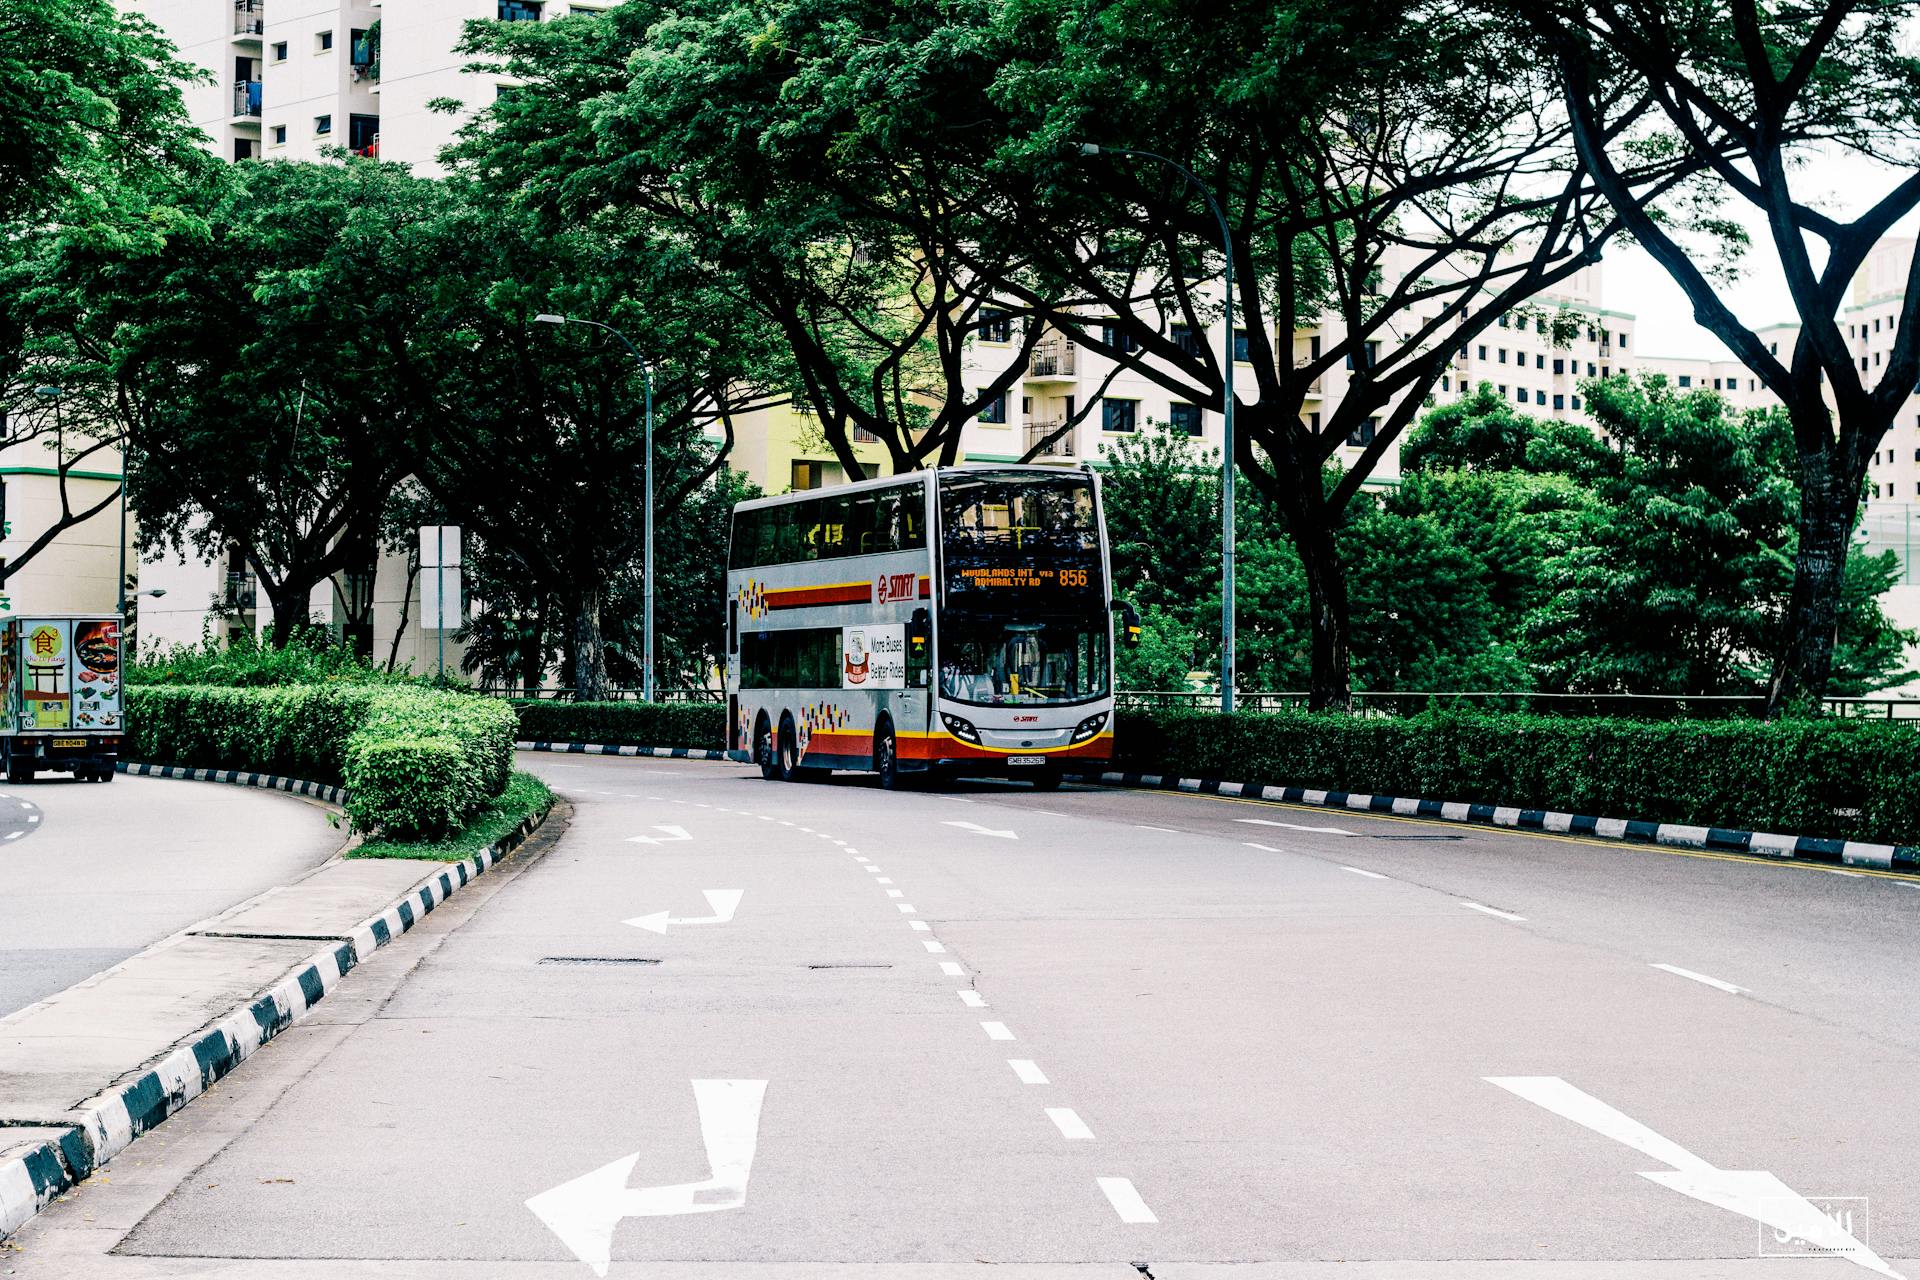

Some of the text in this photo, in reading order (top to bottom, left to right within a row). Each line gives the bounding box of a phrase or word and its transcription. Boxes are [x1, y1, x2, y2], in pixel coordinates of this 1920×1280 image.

[975, 578, 1040, 586] ADMIRALTY RD
[1017, 569, 1034, 577] INT
[1059, 569, 1087, 587] 856
[888, 573, 915, 599] SMRT
[871, 635, 902, 653] More Buses
[871, 662, 888, 680] Better
[889, 661, 904, 679] Rides
